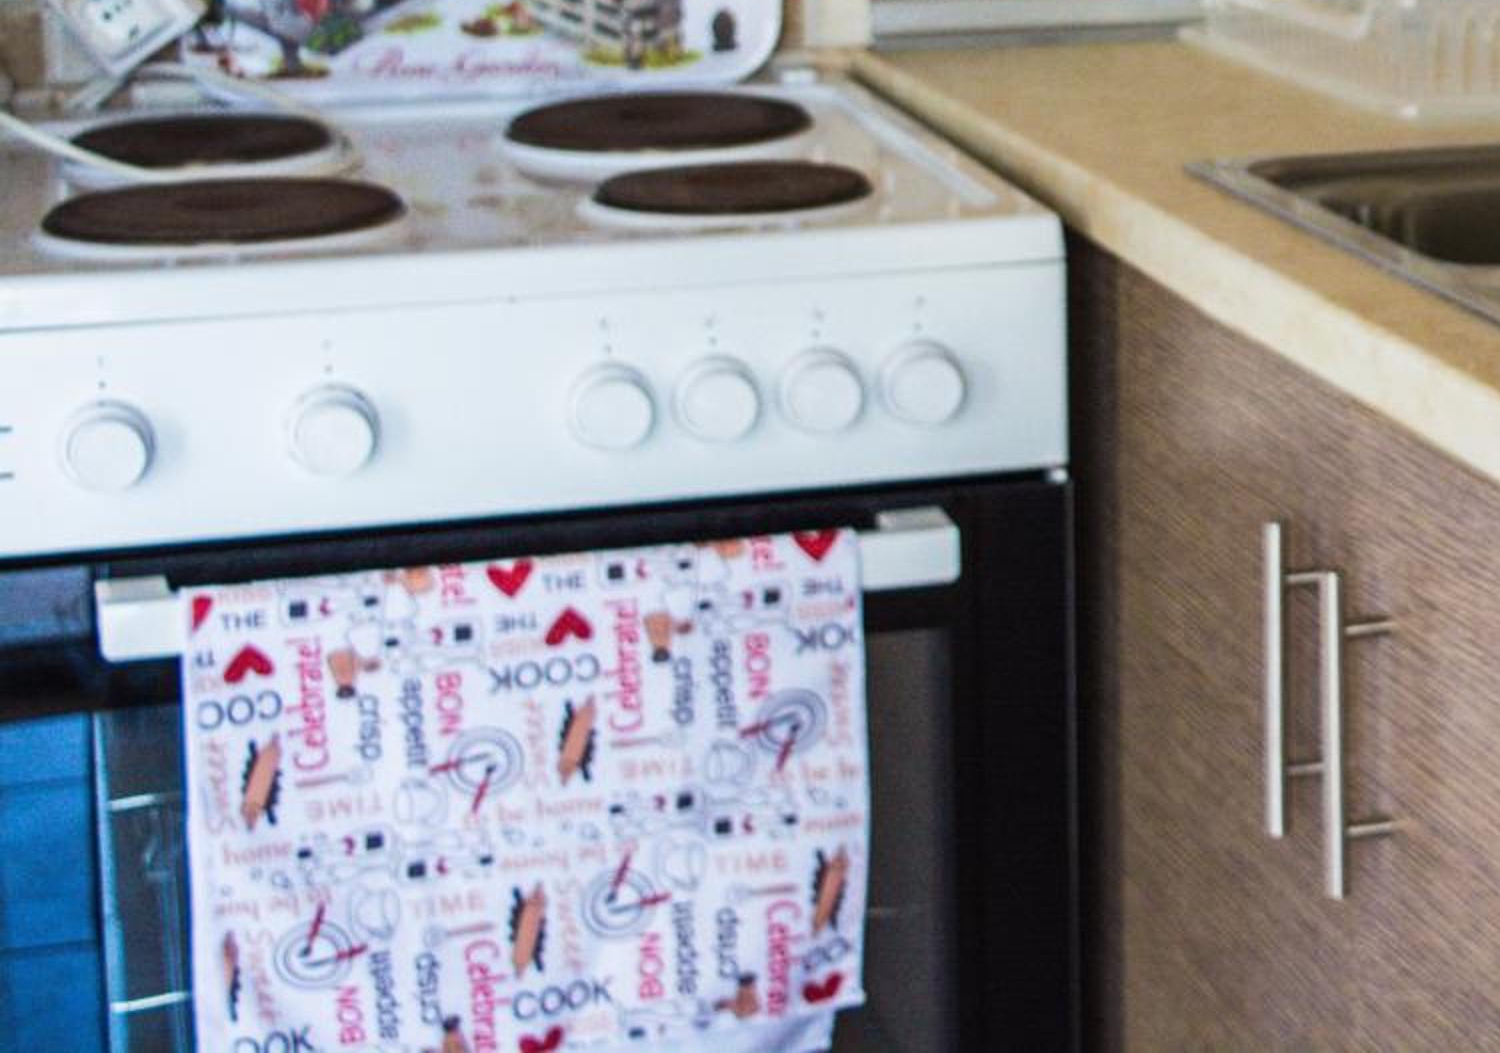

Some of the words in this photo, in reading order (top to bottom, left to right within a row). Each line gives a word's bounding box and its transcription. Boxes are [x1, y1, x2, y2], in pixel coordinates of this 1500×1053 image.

[542, 571, 585, 593] THE
[220, 609, 266, 631] THE
[488, 651, 601, 695] COOK
[744, 632, 771, 700] BON
[285, 635, 330, 771] Celebrate!
[356, 694, 383, 761] crisp
[435, 671, 463, 736] BON
[638, 932, 665, 1001] BON
[336, 986, 367, 1045] BON
[512, 978, 614, 1021] COOK
